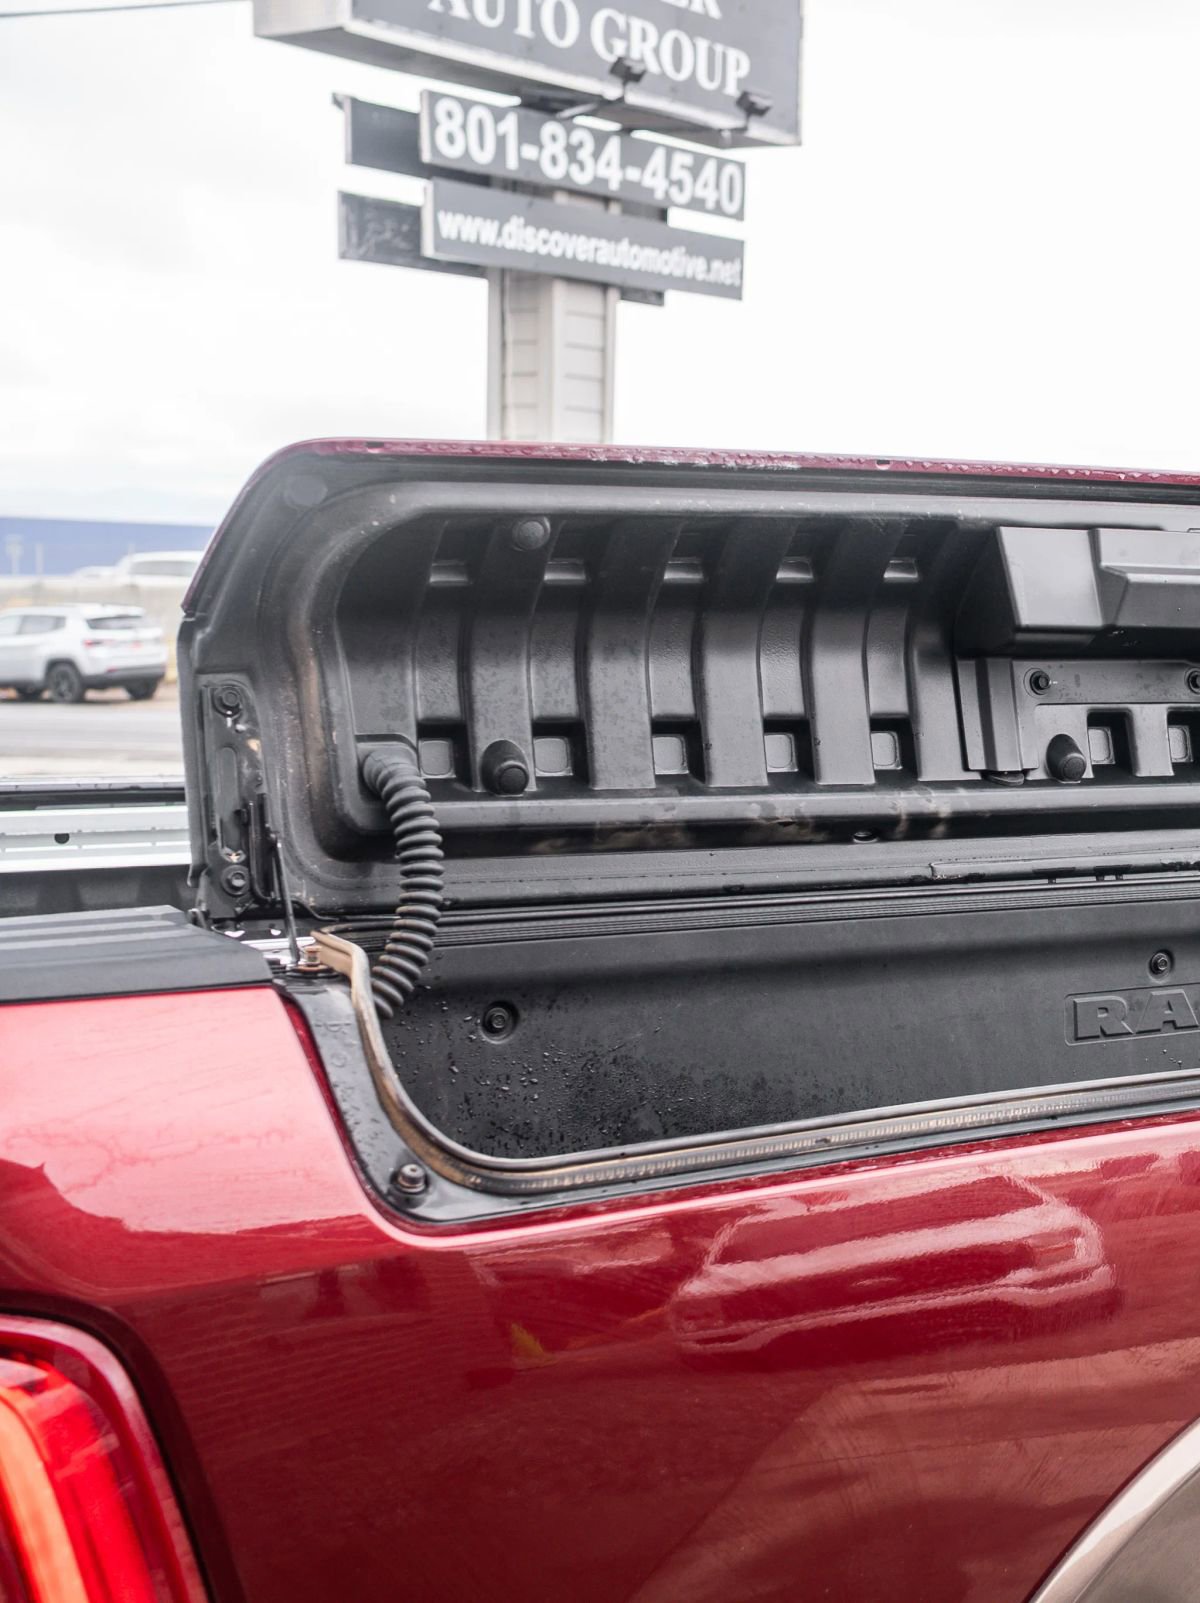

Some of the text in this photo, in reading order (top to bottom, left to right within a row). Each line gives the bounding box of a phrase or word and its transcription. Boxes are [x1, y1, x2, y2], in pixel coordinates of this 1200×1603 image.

[427, 0, 750, 98] UTO GROUP
[434, 98, 744, 214] 801-834-4540
[437, 211, 741, 286] www.discoverautomotive.net
